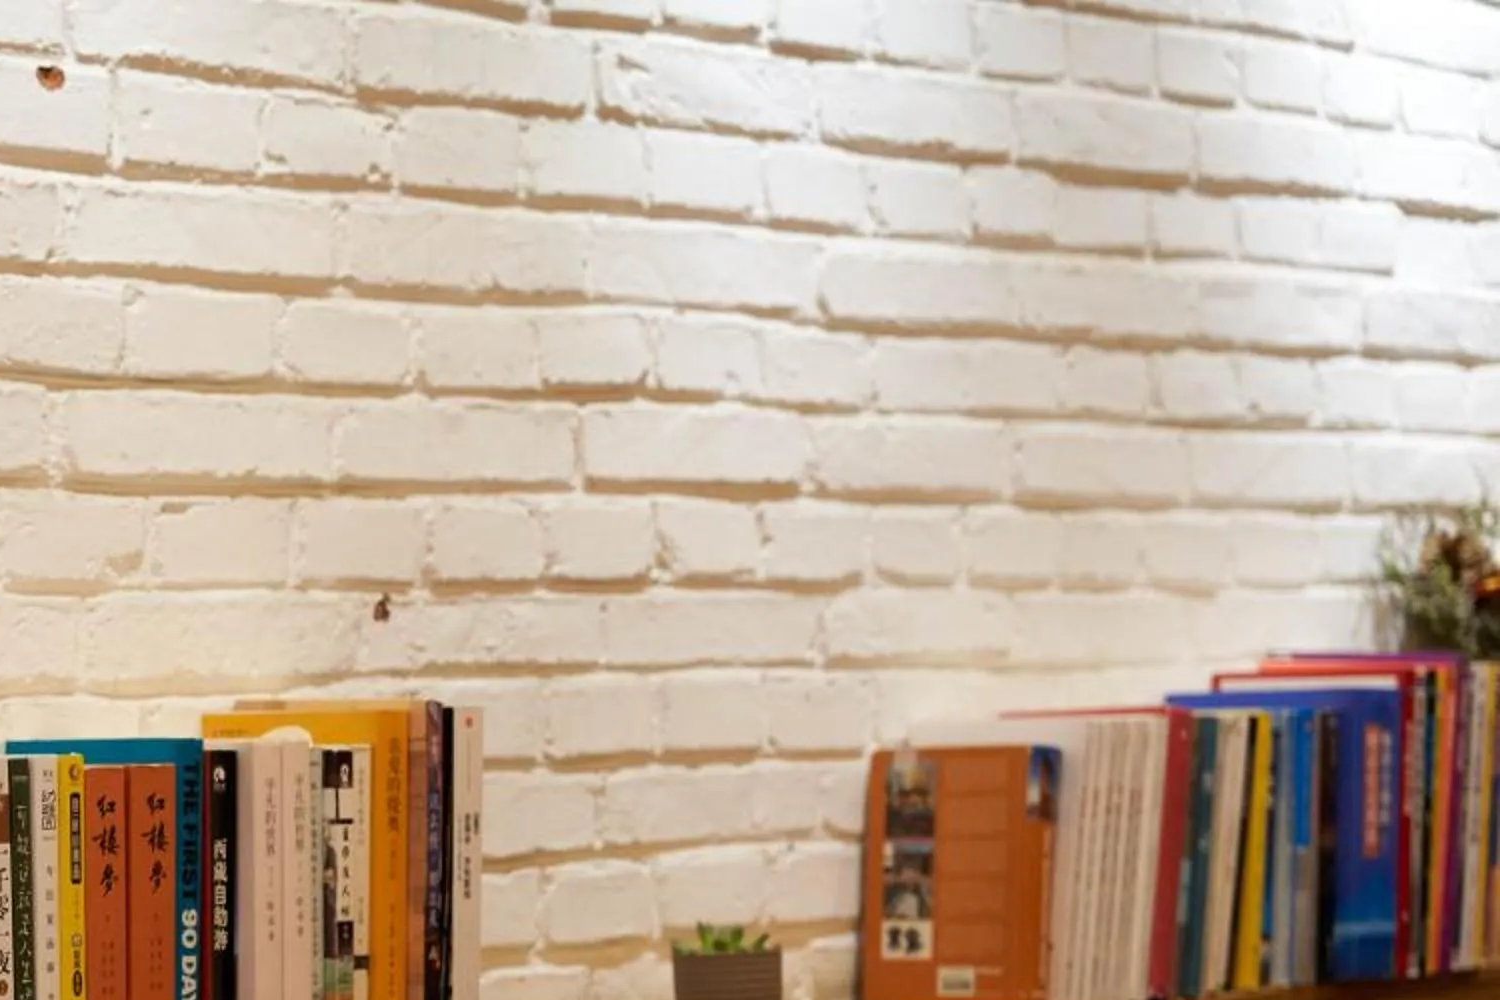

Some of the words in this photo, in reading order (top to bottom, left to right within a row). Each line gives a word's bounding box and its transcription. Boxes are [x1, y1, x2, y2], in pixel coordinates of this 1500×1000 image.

[182, 764, 200, 817] THE
[182, 822, 200, 902] FIRST
[181, 908, 198, 949] 90
